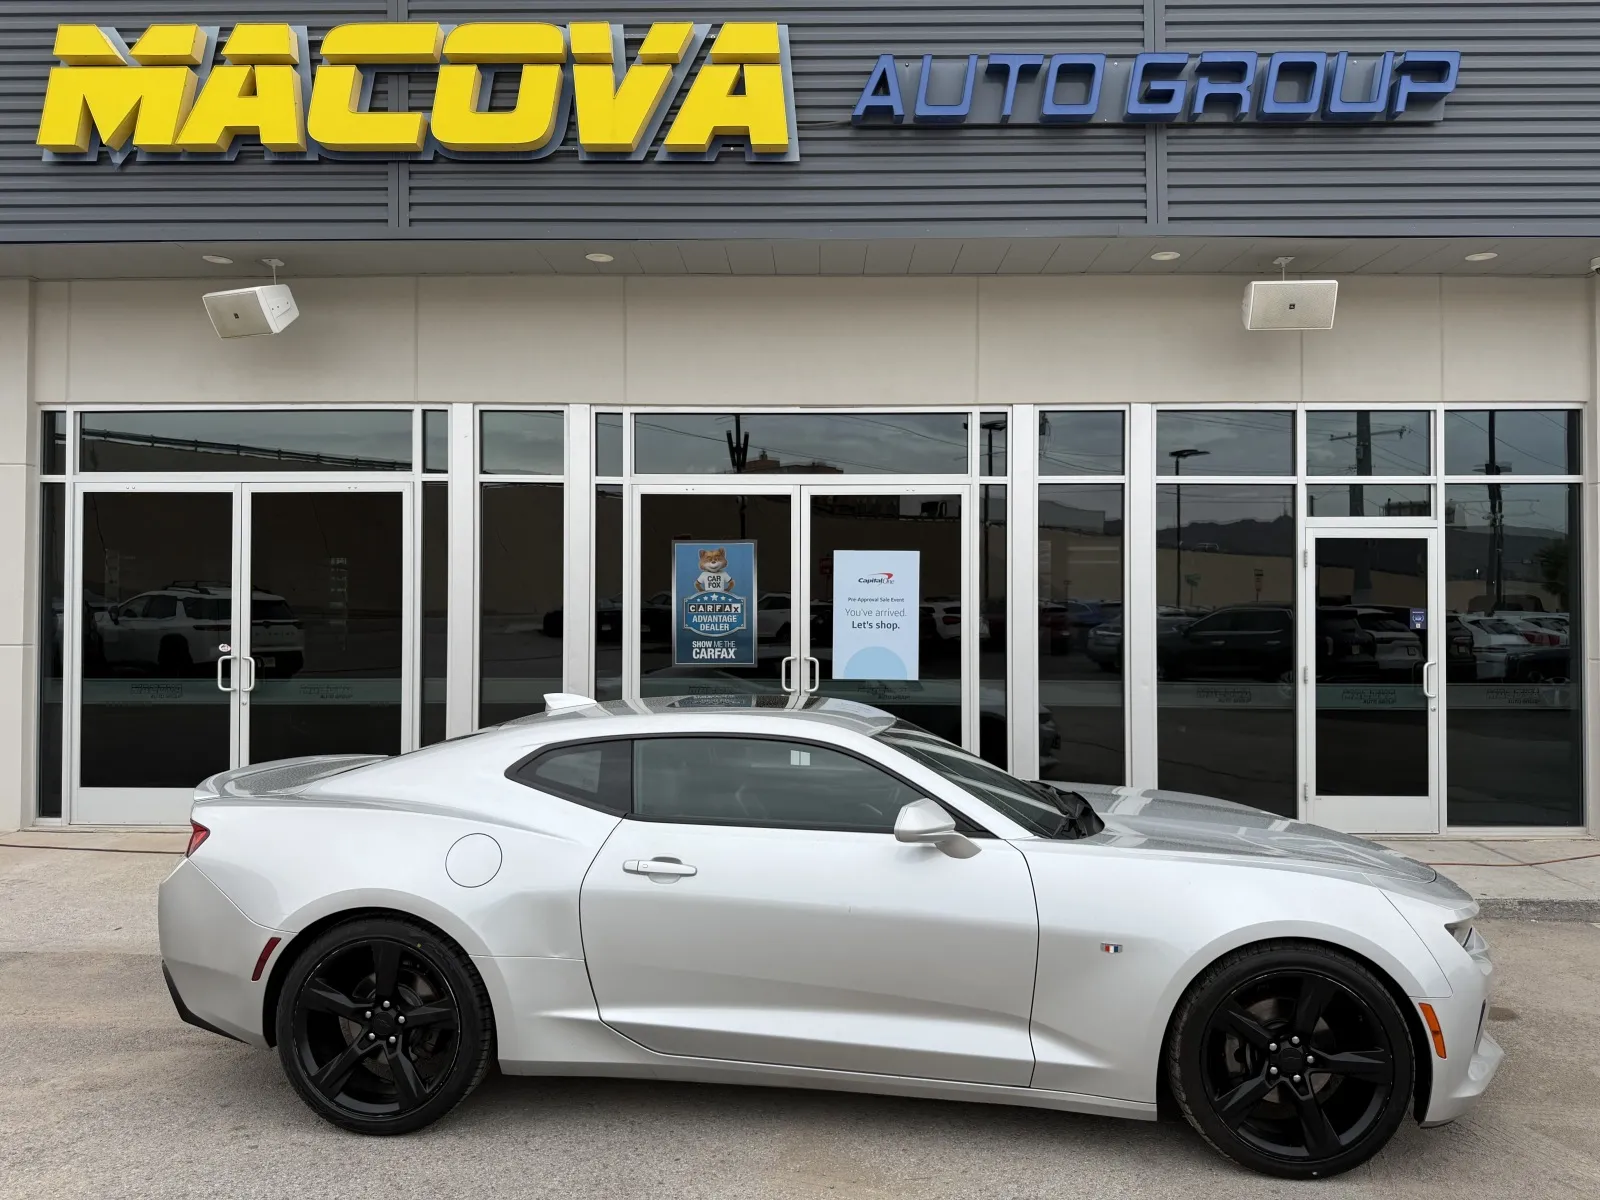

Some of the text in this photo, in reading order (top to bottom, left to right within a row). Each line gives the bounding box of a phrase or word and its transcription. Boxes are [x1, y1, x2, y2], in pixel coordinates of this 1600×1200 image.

[36, 22, 797, 160] MACOVA
[851, 50, 1461, 127] AUTO GROUP
[689, 604, 740, 613] CARFAX
[845, 607, 907, 618] You've arrived.
[692, 615, 737, 623] ADVANTAGE
[699, 623, 730, 631] DEALER
[852, 620, 900, 631] Let's shop.
[692, 640, 736, 648] SHOW ME THE
[692, 648, 737, 659] CARFAX
